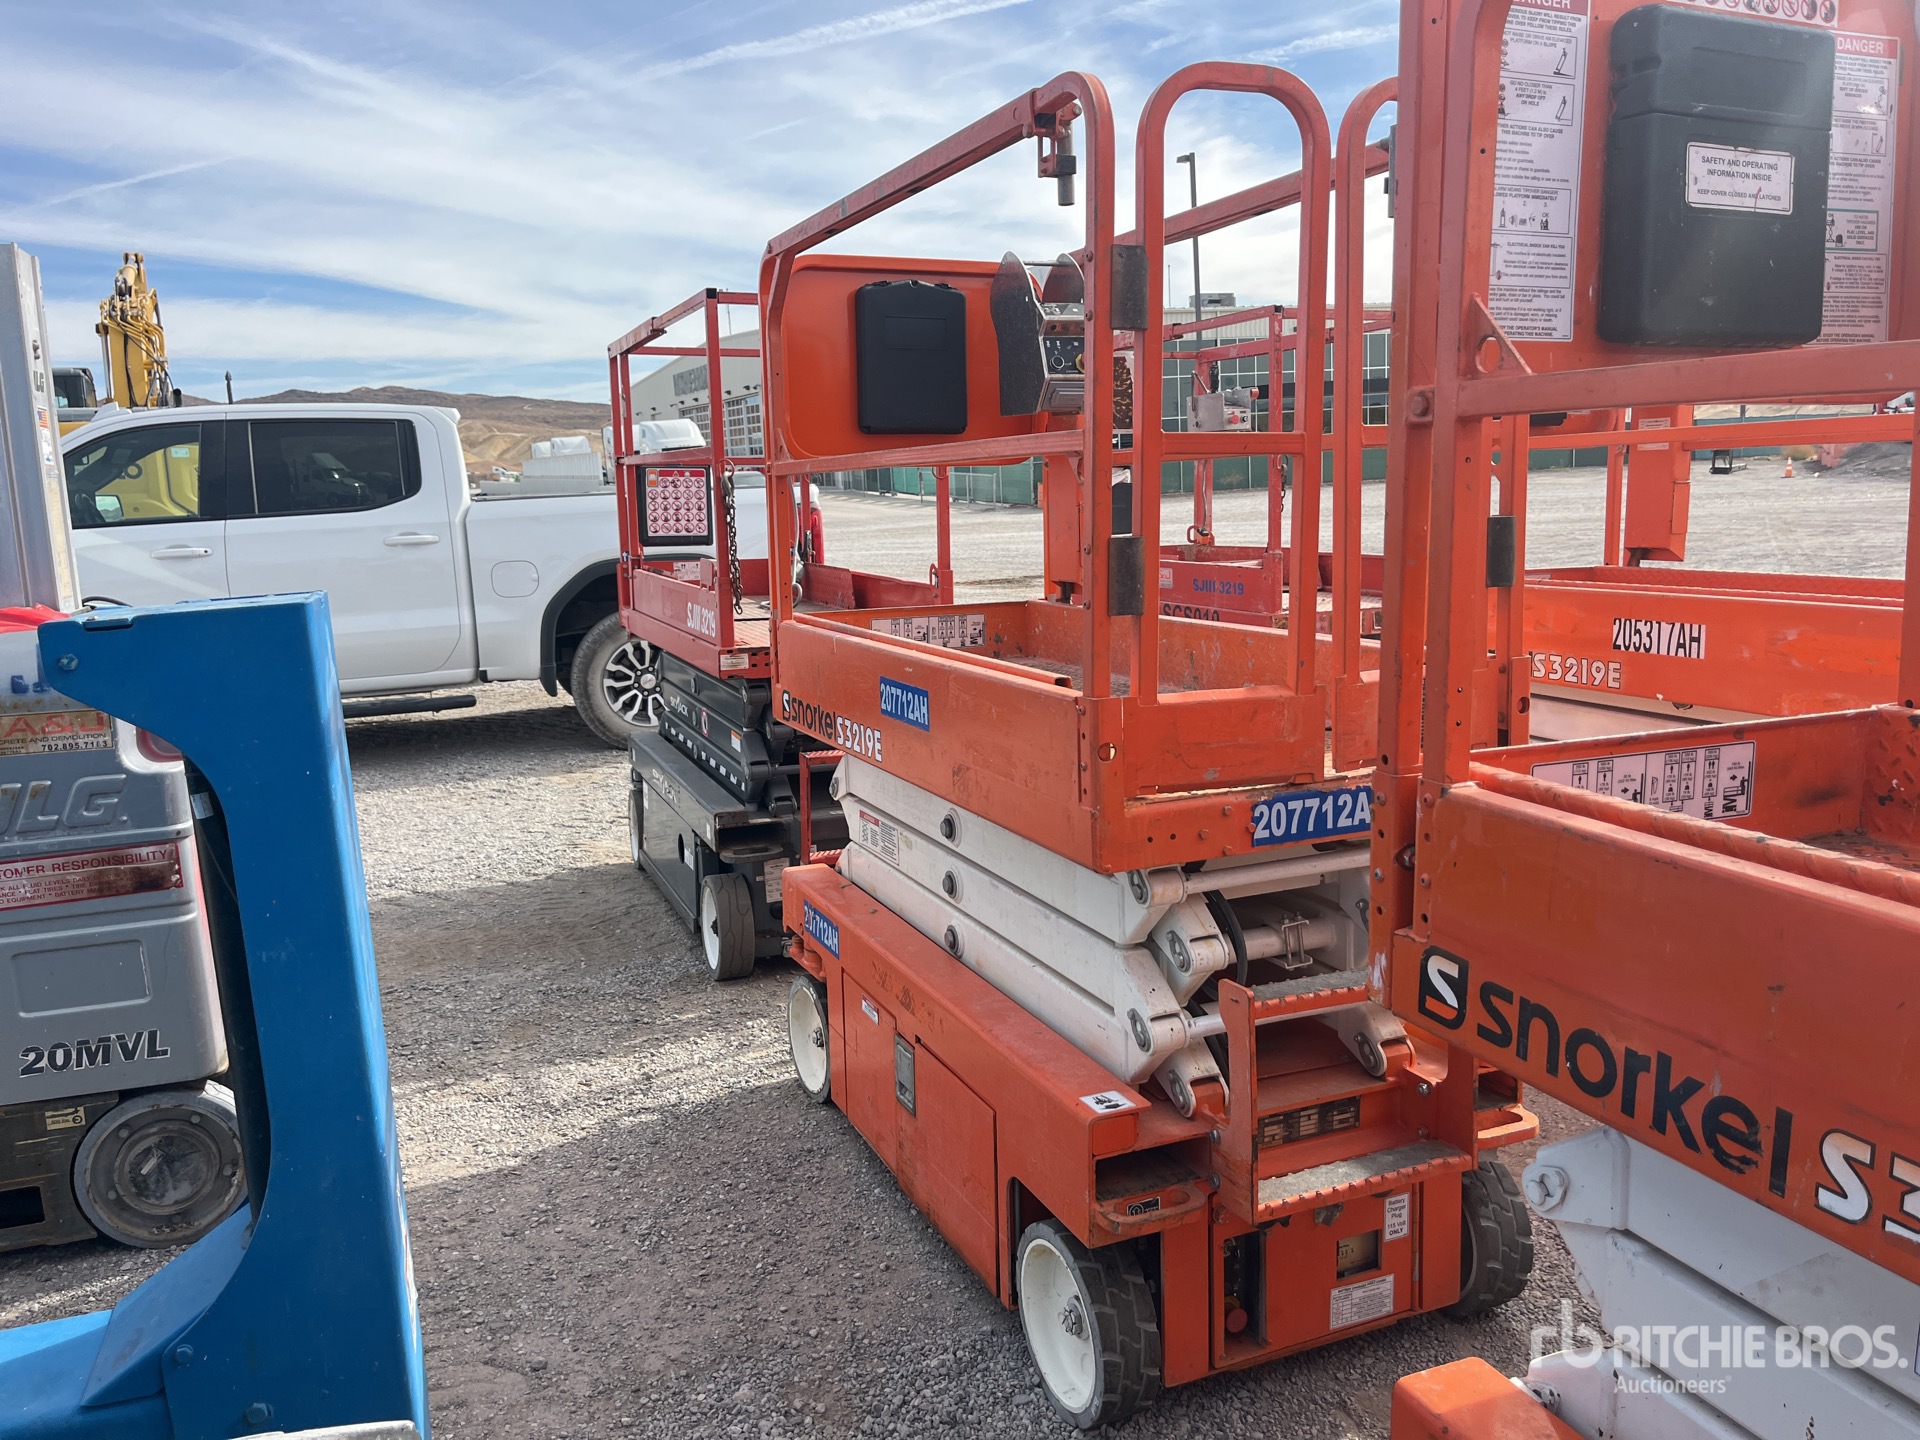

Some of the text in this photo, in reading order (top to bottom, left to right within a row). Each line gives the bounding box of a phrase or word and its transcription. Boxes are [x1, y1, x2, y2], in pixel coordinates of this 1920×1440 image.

[1837, 37, 1884, 54] DANGER
[1702, 156, 1778, 171] SAFETY AND OPERATING
[1707, 169, 1772, 181] INFORMATION INSIDE
[1220, 581, 1244, 596] 3219
[1613, 618, 1702, 659] 205317AH
[1533, 653, 1622, 689] S3219E
[880, 682, 929, 726] 207712AH
[51, 733, 106, 741] DEMOLITION
[791, 698, 837, 741] snorkel
[836, 716, 882, 762] S3219E
[52, 850, 168, 873] RESPONSIBILITY
[7, 894, 46, 904] EQUIPMENT
[19, 1028, 171, 1079] 20MVL
[1476, 980, 1793, 1199] snorkel
[1387, 1205, 1406, 1213] Charger
[1388, 1198, 1405, 1206] Battery
